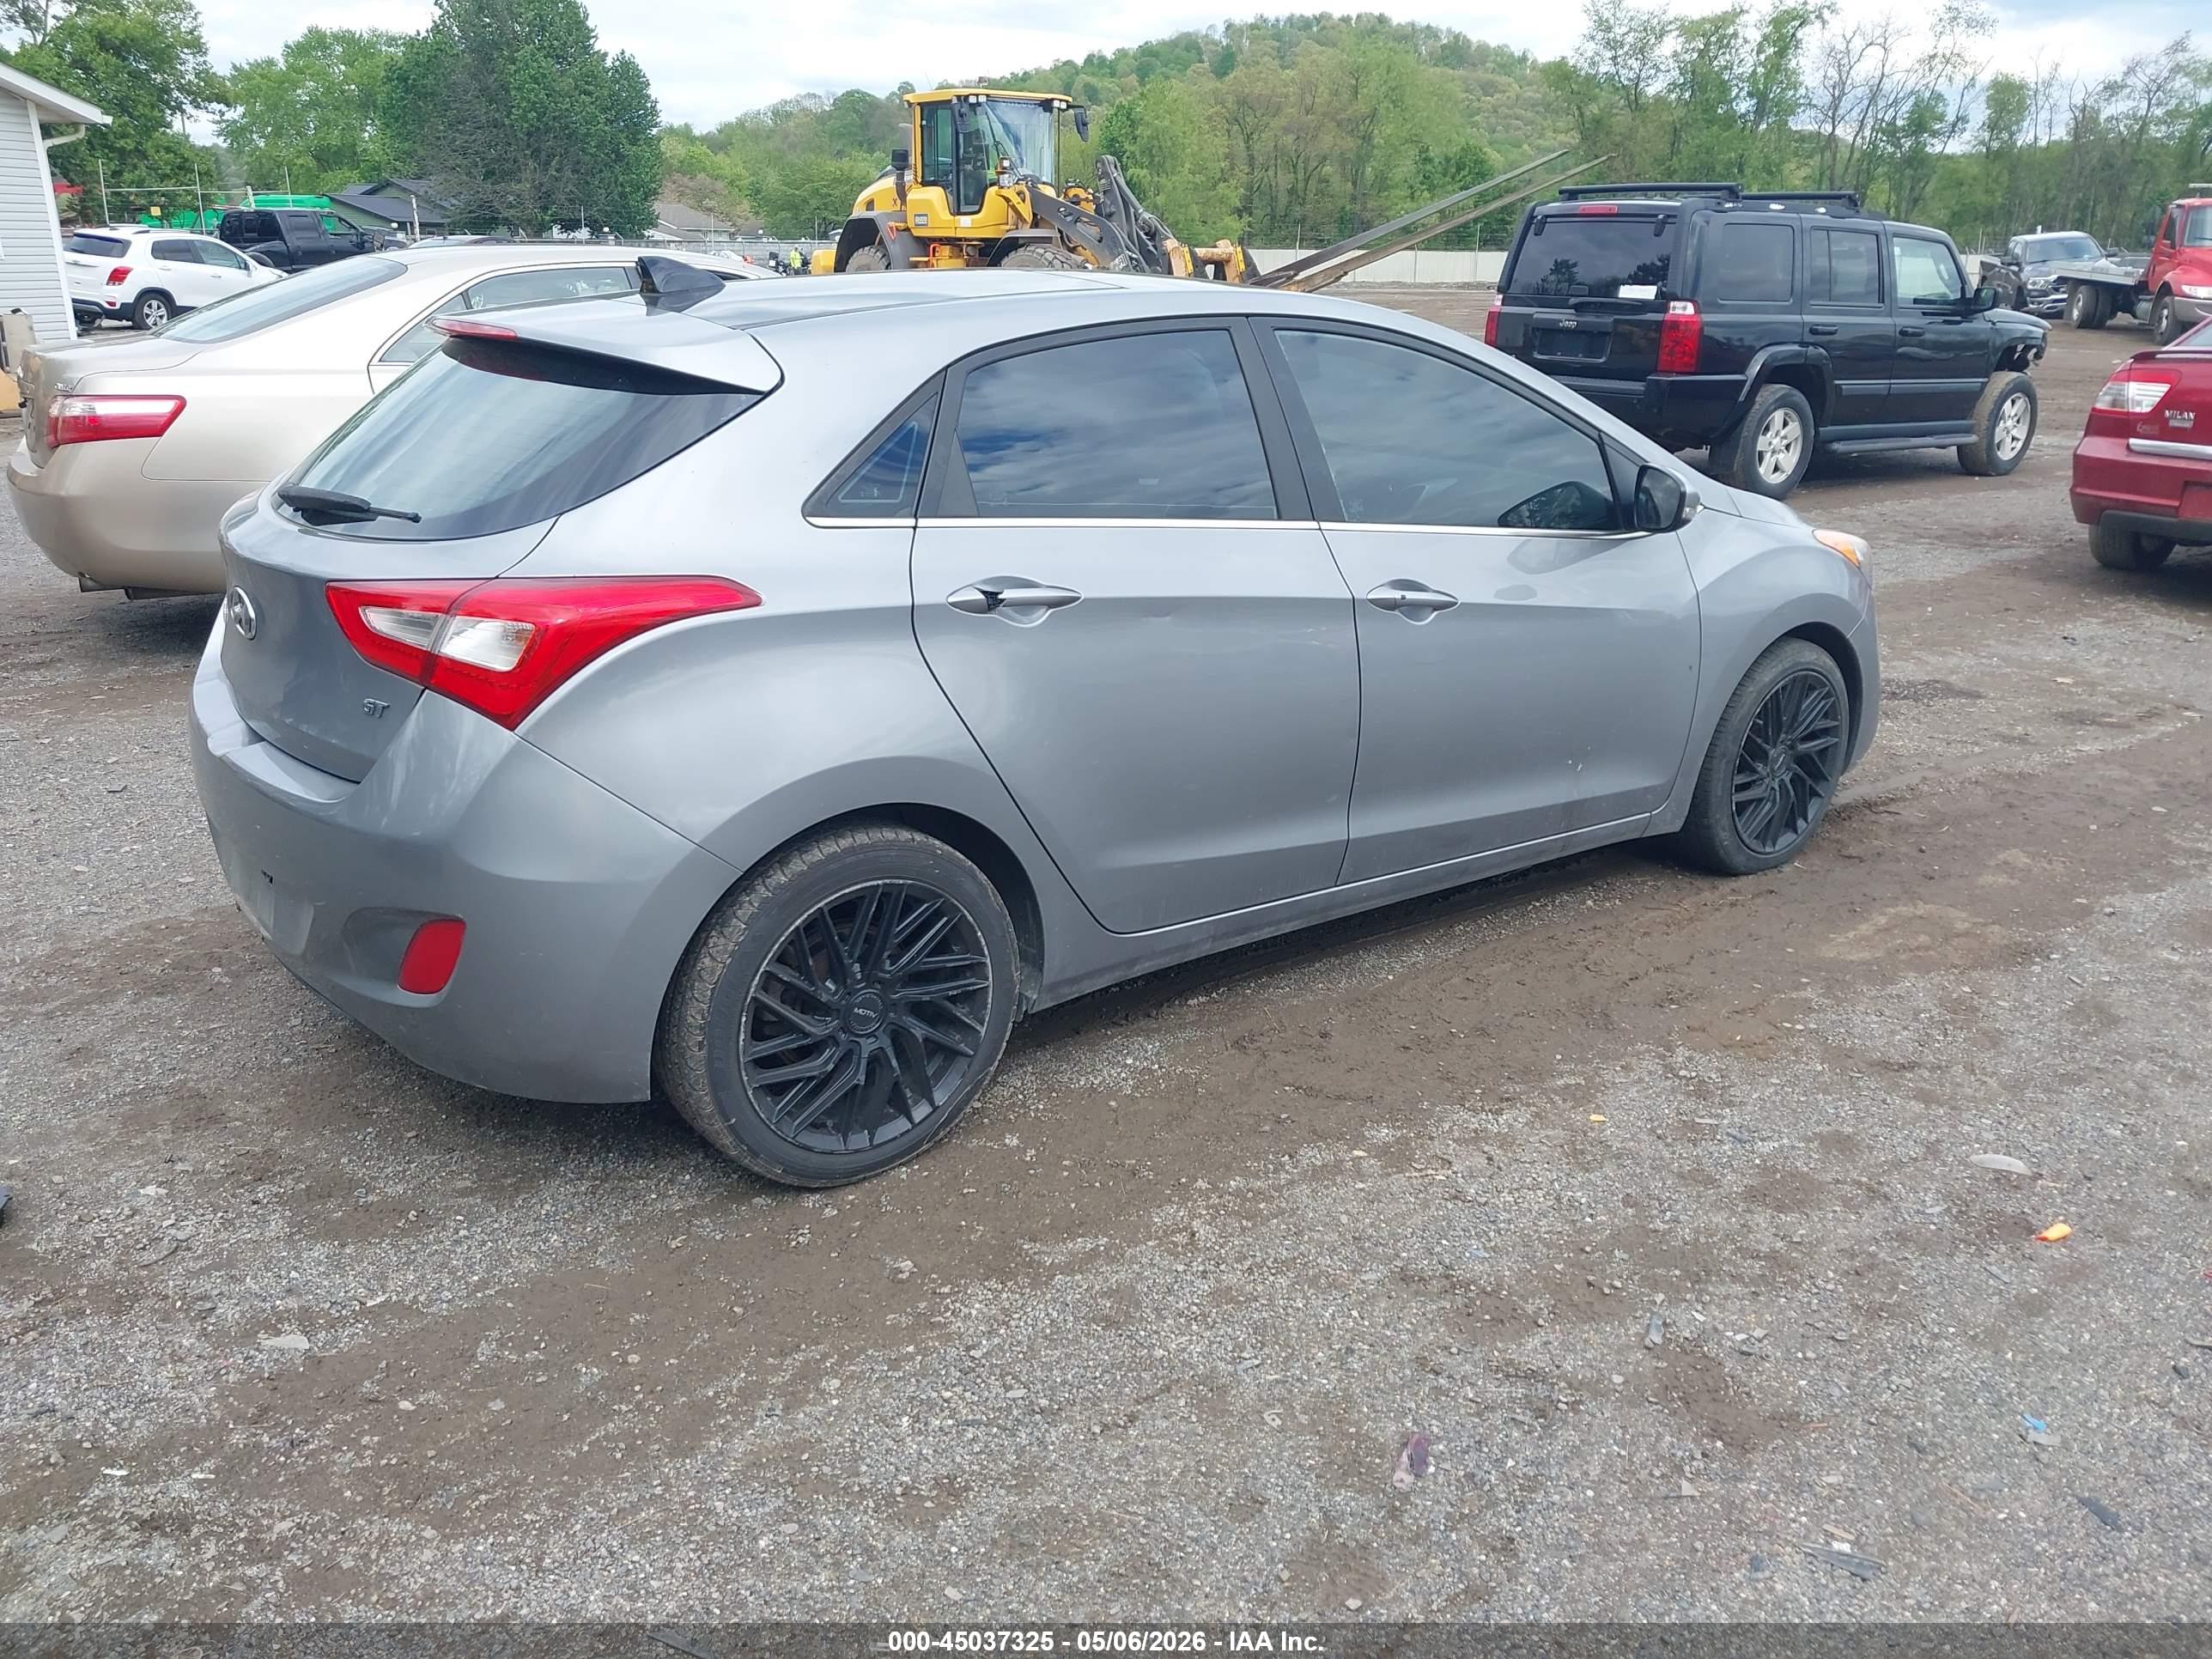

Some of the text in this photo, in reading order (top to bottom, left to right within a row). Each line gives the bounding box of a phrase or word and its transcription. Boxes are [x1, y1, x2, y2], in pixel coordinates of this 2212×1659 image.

[1559, 318, 1577, 329] Jeep
[2164, 410, 2196, 420] MILAN
[364, 698, 390, 718] GT
